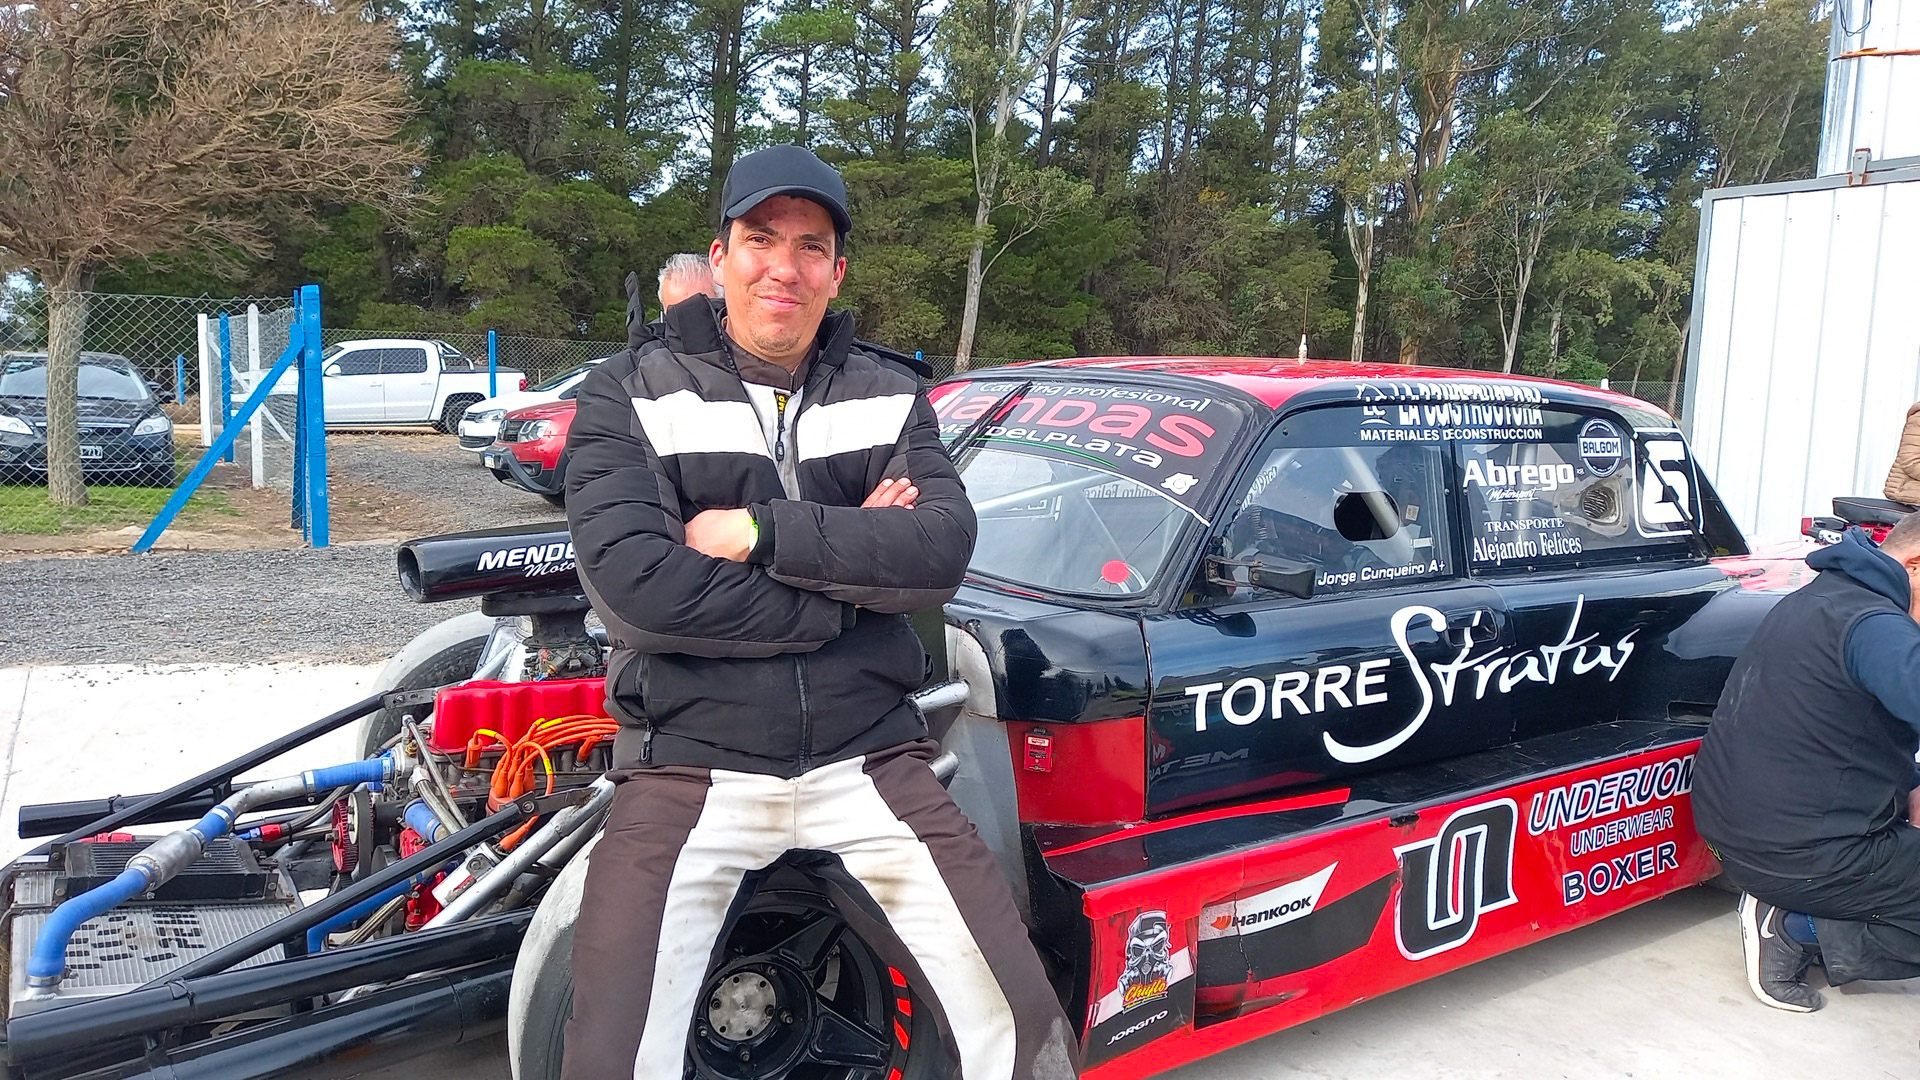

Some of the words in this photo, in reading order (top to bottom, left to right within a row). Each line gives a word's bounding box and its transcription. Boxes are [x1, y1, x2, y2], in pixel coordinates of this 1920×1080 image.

[979, 382, 1064, 397] Cating
[1063, 385, 1212, 413] profesional
[1360, 429, 1440, 441] MATERIALES
[1456, 428, 1543, 440] CONSTRUCCION
[1582, 441, 1619, 454] BALGOM
[1462, 459, 1575, 491] Abrego
[1485, 487, 1541, 502] Motorsport
[1483, 518, 1565, 532] TRANSPORTE
[1473, 534, 1538, 566] Alejandro
[1538, 532, 1583, 556] Felices
[1317, 571, 1357, 586] Jorge
[1361, 562, 1426, 582] Cunqueiro
[1428, 558, 1447, 574] A+
[1184, 658, 1391, 732] TORRE
[1322, 594, 1641, 763] Stratus
[1570, 805, 1674, 857] UNDERWEAR
[1562, 841, 1680, 906] BOXER
[1106, 1010, 1169, 1046] JORGITO
